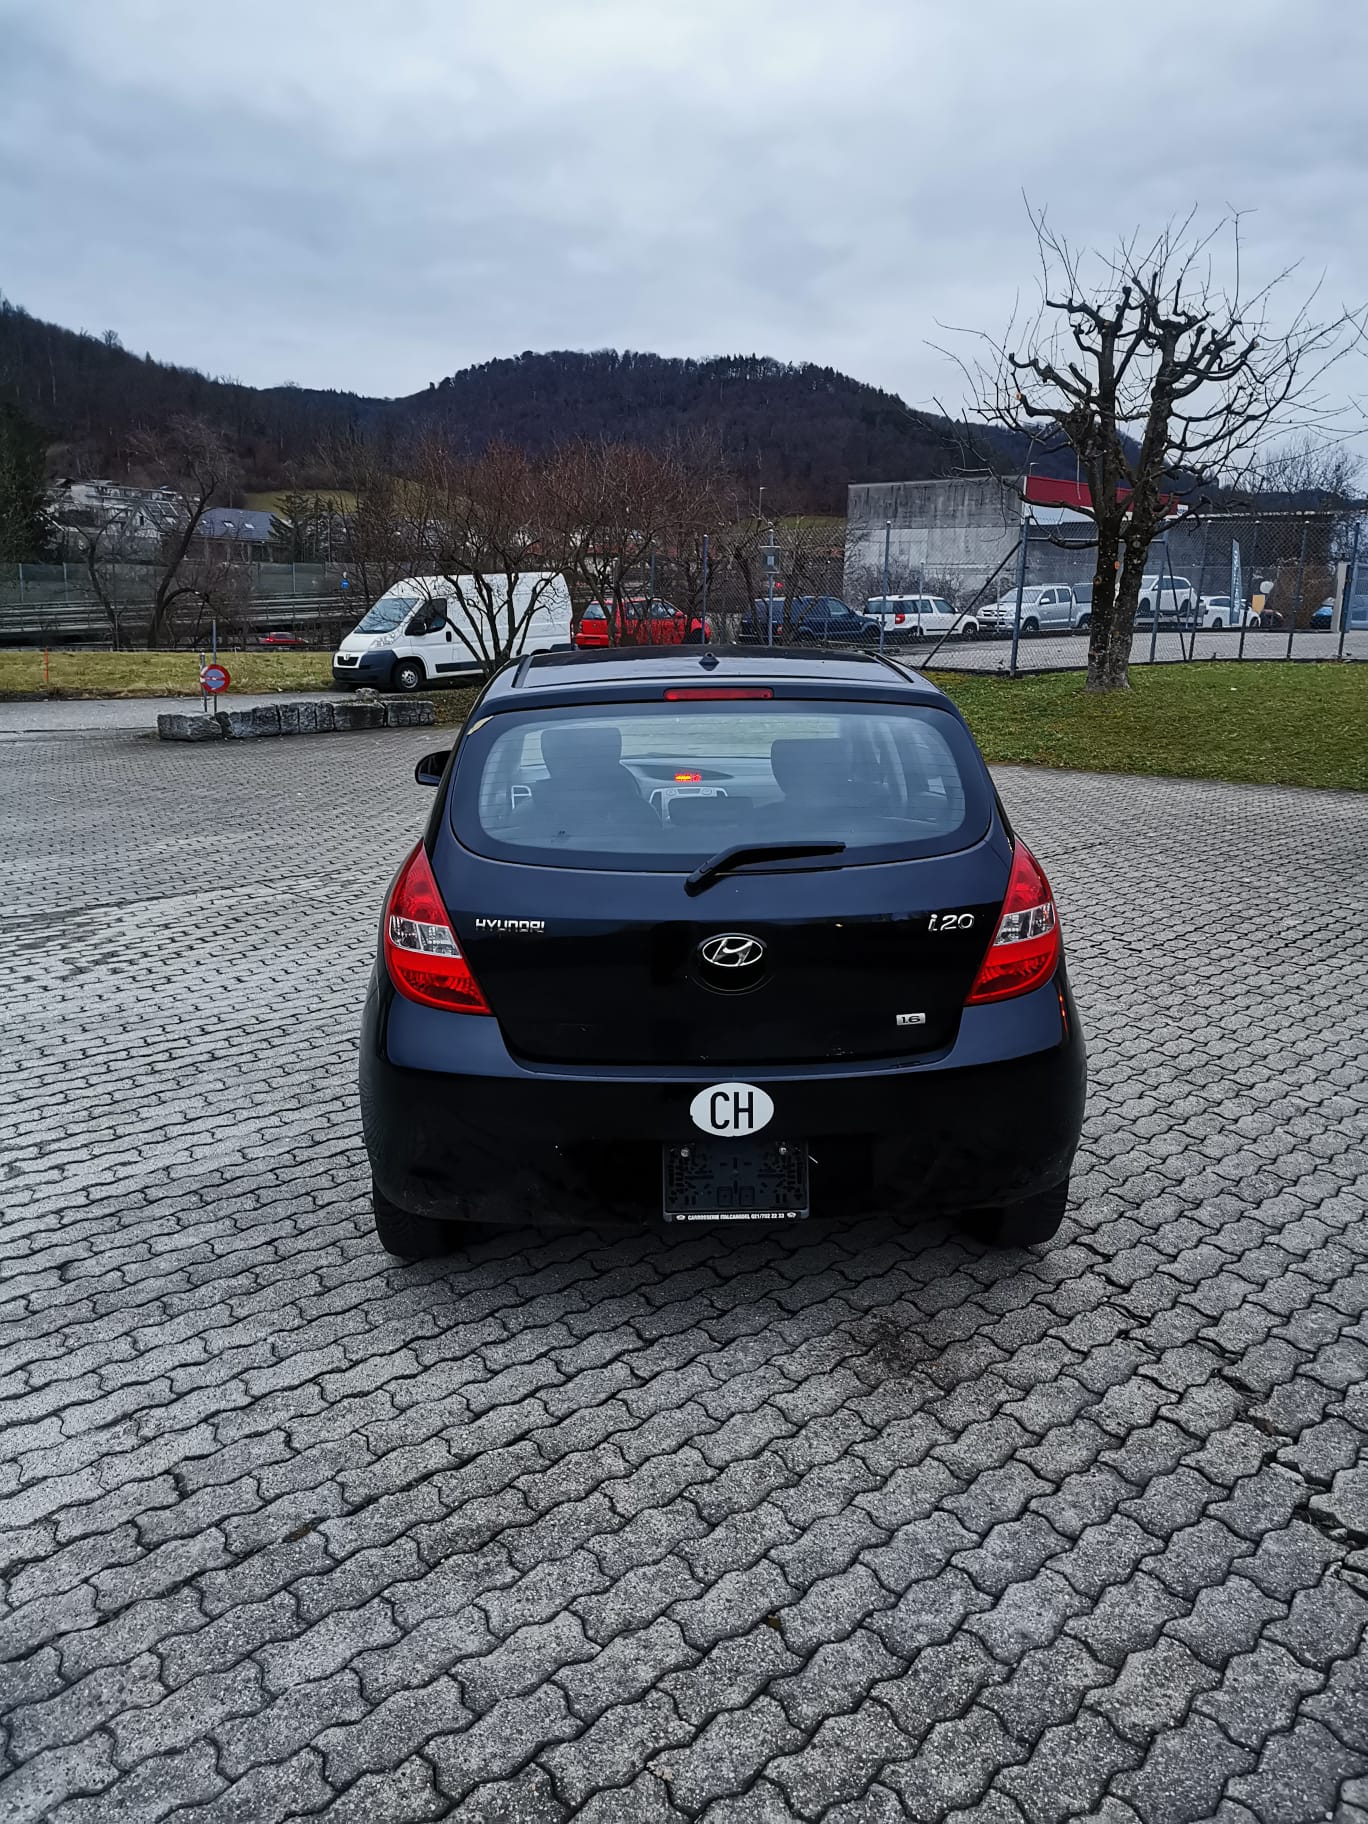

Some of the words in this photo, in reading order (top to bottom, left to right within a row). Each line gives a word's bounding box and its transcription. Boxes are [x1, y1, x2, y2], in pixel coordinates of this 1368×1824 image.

[475, 918, 545, 933] HYUNDAI
[928, 913, 975, 932] i20
[710, 1088, 754, 1130] CH
